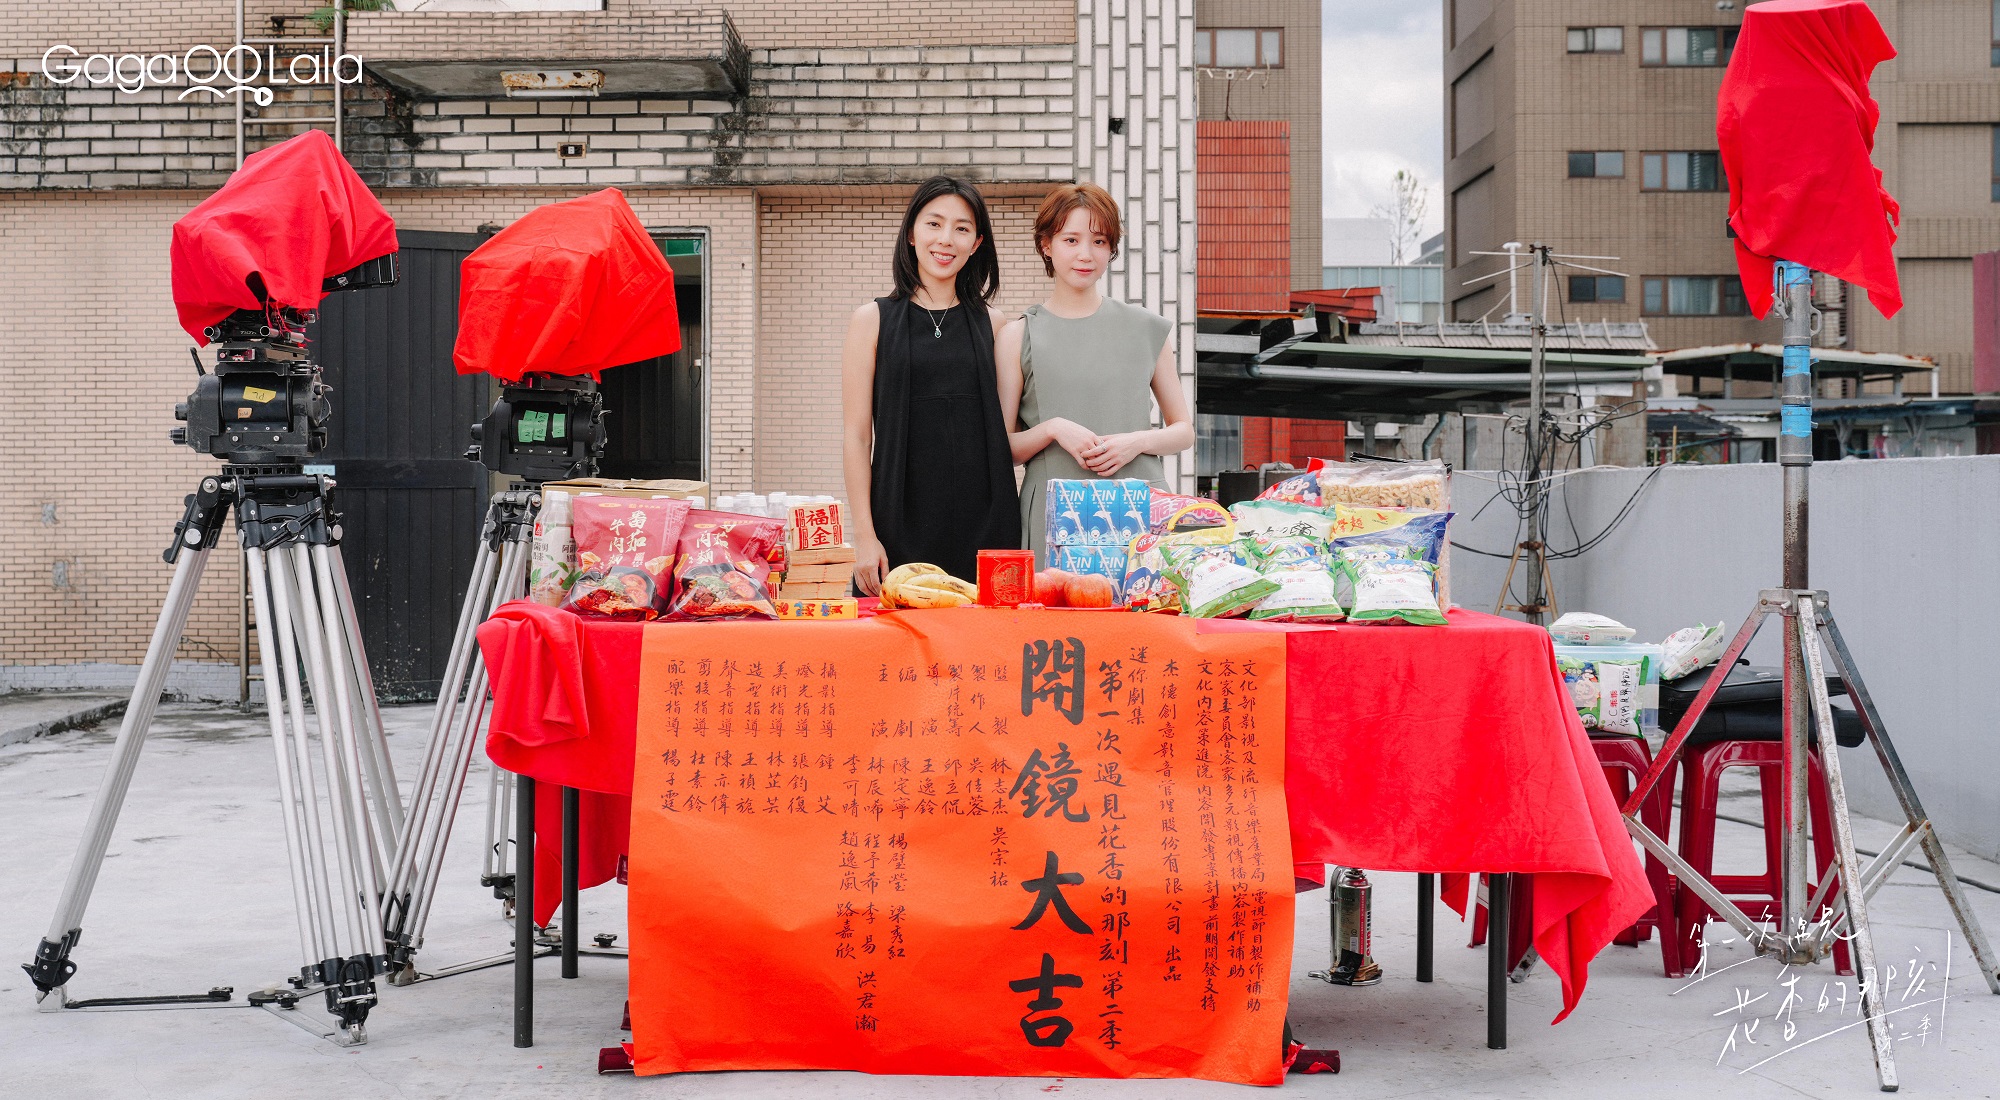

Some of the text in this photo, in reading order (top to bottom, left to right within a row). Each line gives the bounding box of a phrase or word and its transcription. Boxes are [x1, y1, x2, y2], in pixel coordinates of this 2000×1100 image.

[625, 509, 648, 553] 番茄
[806, 509, 832, 547] 福金
[660, 659, 686, 813] 配樂指導 楊子霆
[683, 658, 712, 813] 剪接指導 杜素鈴
[711, 659, 741, 816] 聲音指導 陳亦偉
[745, 661, 765, 738] 造型指導
[763, 661, 788, 814] 美術指導 林芷芸
[794, 662, 815, 738] 燈光指導
[818, 662, 838, 738] 攝影指導
[893, 666, 917, 738] 編劇
[914, 662, 943, 815] 導演 王逸鈴
[965, 664, 988, 817] 製作人 吳佳蓉
[1127, 645, 1149, 726] 迷你劇集
[1195, 659, 1214, 779] 文化內容策進院
[891, 757, 911, 820] 陳定寧
[941, 758, 965, 815] 邱立侃
[990, 757, 1012, 815] 林志杰
[1008, 636, 1095, 1048] 開鏡大吉
[1154, 659, 1183, 982] 杰德創意影音管理股份有限公司 出品
[835, 753, 861, 960] 李可晴 趙逸嵐 路嘉欣
[854, 663, 889, 1033] 主演 林辰唏 程予希 李易 洪君瀚
[989, 826, 1009, 888] 吳宗祐
[1093, 659, 1131, 1050] 第一次遇見花香的那刻 第二季
[887, 904, 907, 960] 梁秀紅
[1245, 888, 1268, 1013] 電視節目製作補助
